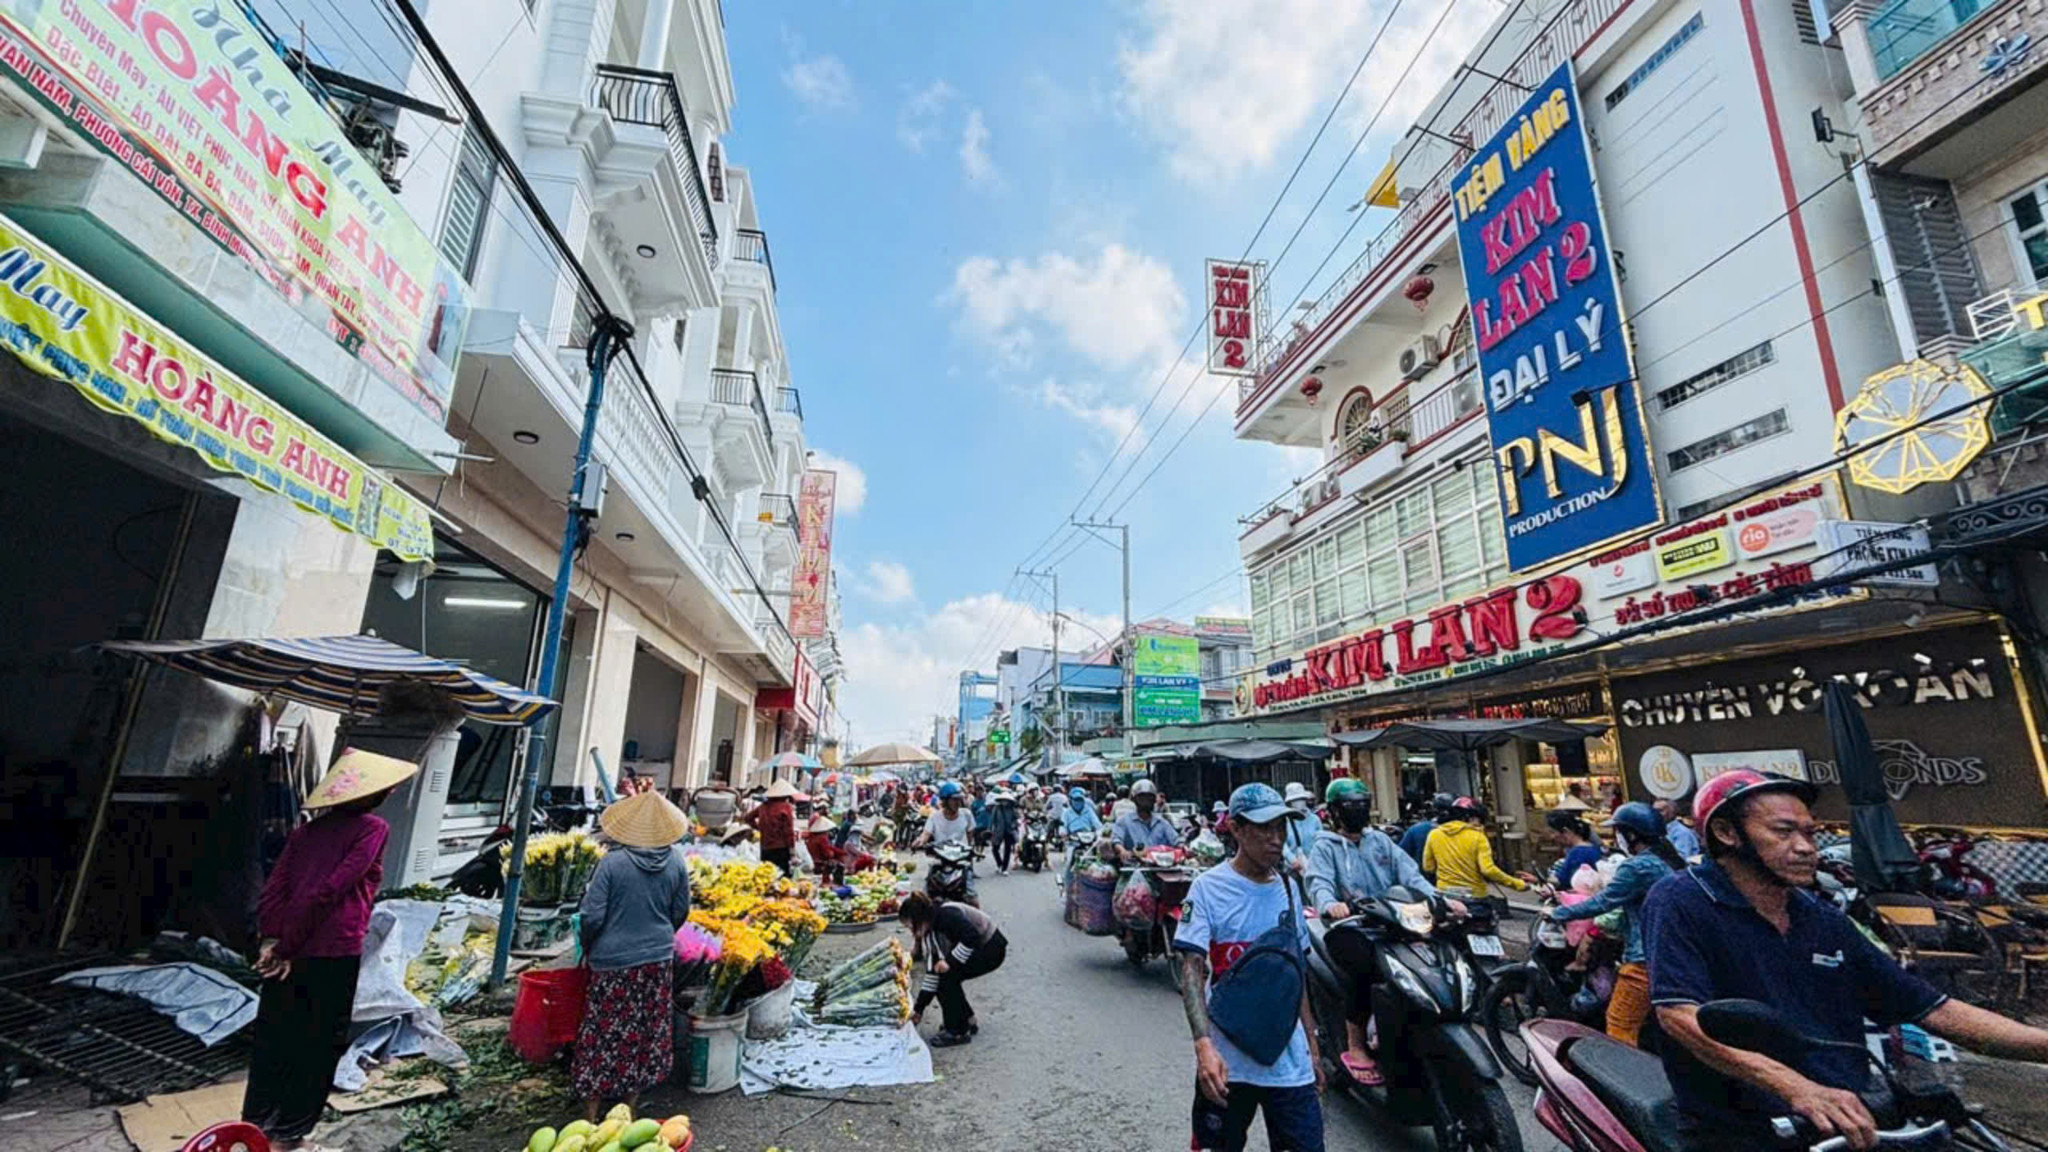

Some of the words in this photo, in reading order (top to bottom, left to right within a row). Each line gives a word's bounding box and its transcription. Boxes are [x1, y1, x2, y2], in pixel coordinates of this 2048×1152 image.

[117, 50, 148, 90] May
[1455, 152, 1506, 223] TIỆM
[1505, 88, 1571, 173] VÀNG
[335, 213, 425, 320] ANH
[1480, 166, 1563, 275] KIM
[0, 246, 88, 331] May
[1214, 308, 1251, 340] LAN
[1215, 279, 1249, 310] KIM
[1474, 245, 1560, 351] LAN
[1560, 220, 1598, 287] 2
[1223, 340, 1246, 370] 2
[1489, 344, 1550, 413] ĐẠI
[1554, 297, 1604, 371] LÝ
[110, 328, 276, 457] HOÀNG
[280, 435, 353, 502] ANH
[1496, 385, 1629, 519] PNJ
[1508, 486, 1608, 539] PRODUCTION
[1304, 627, 1388, 697] KIM
[1391, 584, 1521, 676] LAN
[1525, 574, 1589, 644] 2
[1621, 681, 1753, 728] CHUYÊN
[1808, 756, 1988, 787] DIONDS
